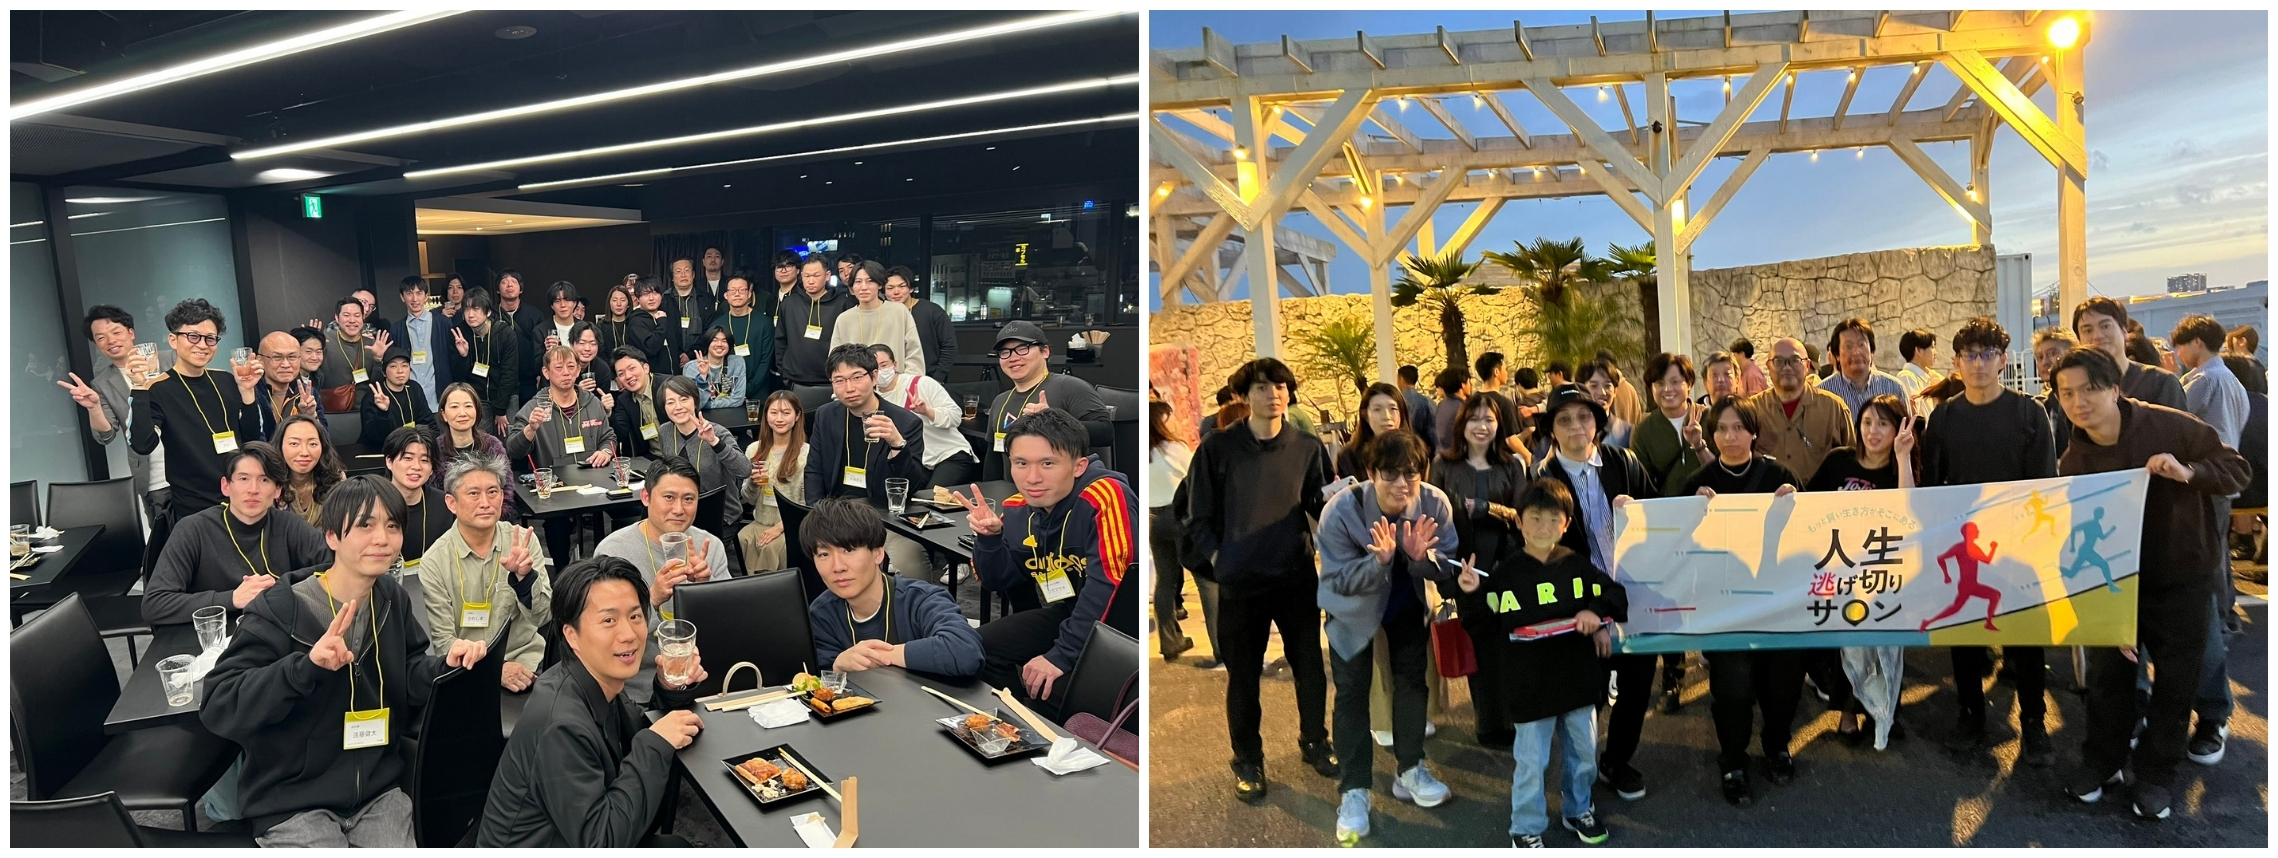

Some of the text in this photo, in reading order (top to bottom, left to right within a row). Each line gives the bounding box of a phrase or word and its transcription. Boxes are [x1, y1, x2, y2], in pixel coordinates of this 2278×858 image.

[1808, 506, 1917, 533] もっと賢い生き方がそこにある
[1814, 526, 1904, 571] 人生
[1807, 569, 1903, 597] 逃げ切り
